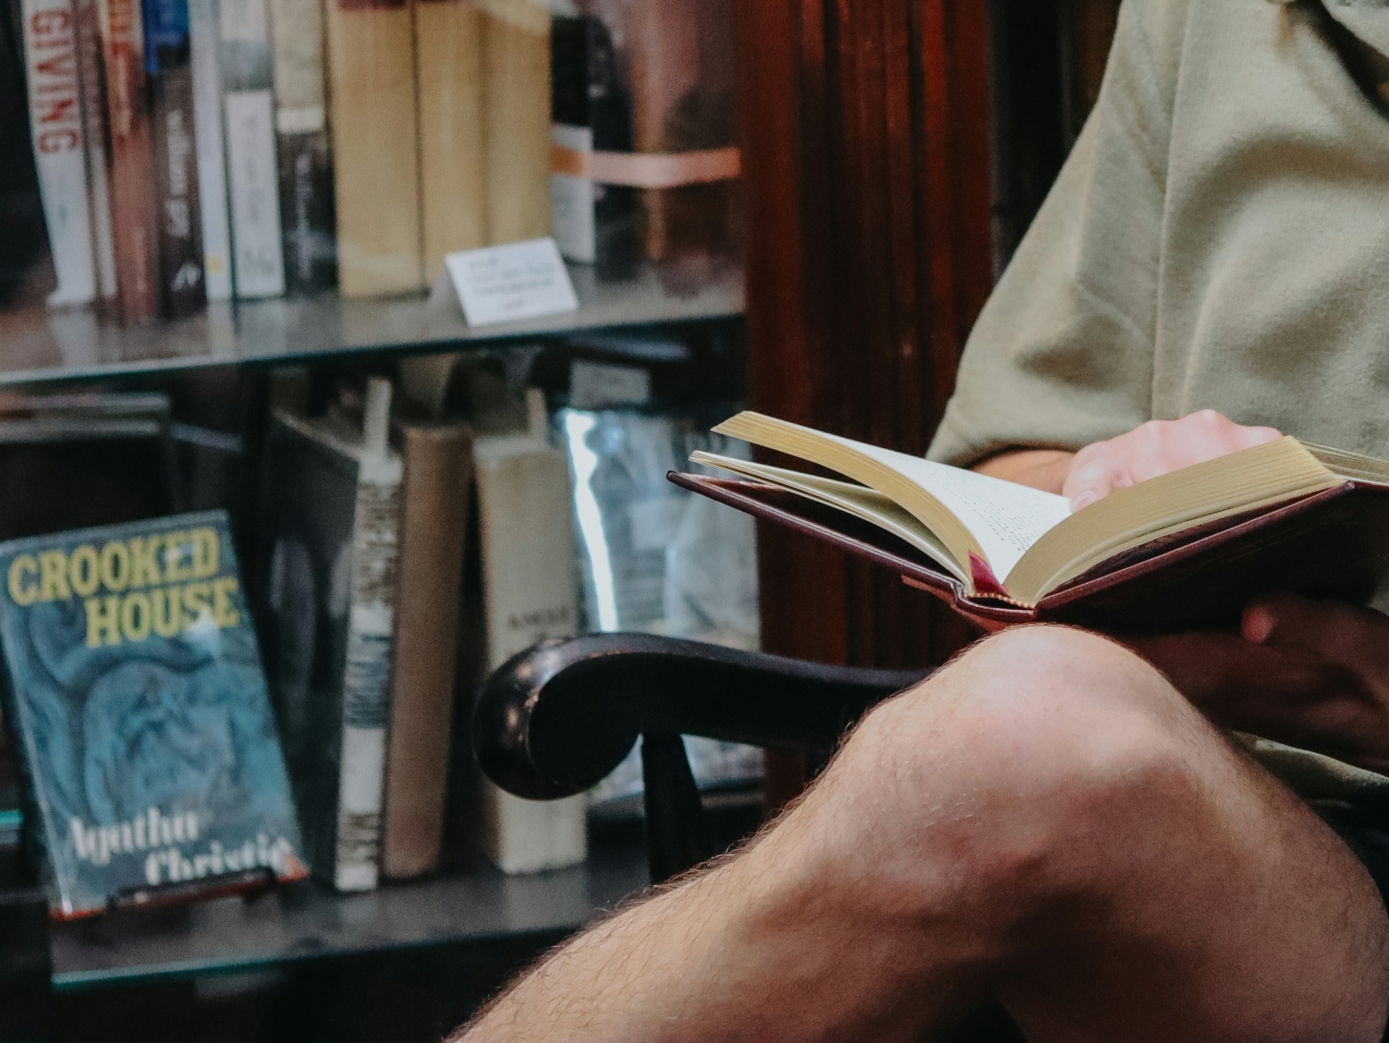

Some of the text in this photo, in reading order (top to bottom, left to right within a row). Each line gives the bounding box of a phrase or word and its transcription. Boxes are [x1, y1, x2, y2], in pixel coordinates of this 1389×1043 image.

[30, 10, 80, 155] GIVING
[8, 526, 220, 607] CROOKED
[84, 576, 240, 650] HOUSE
